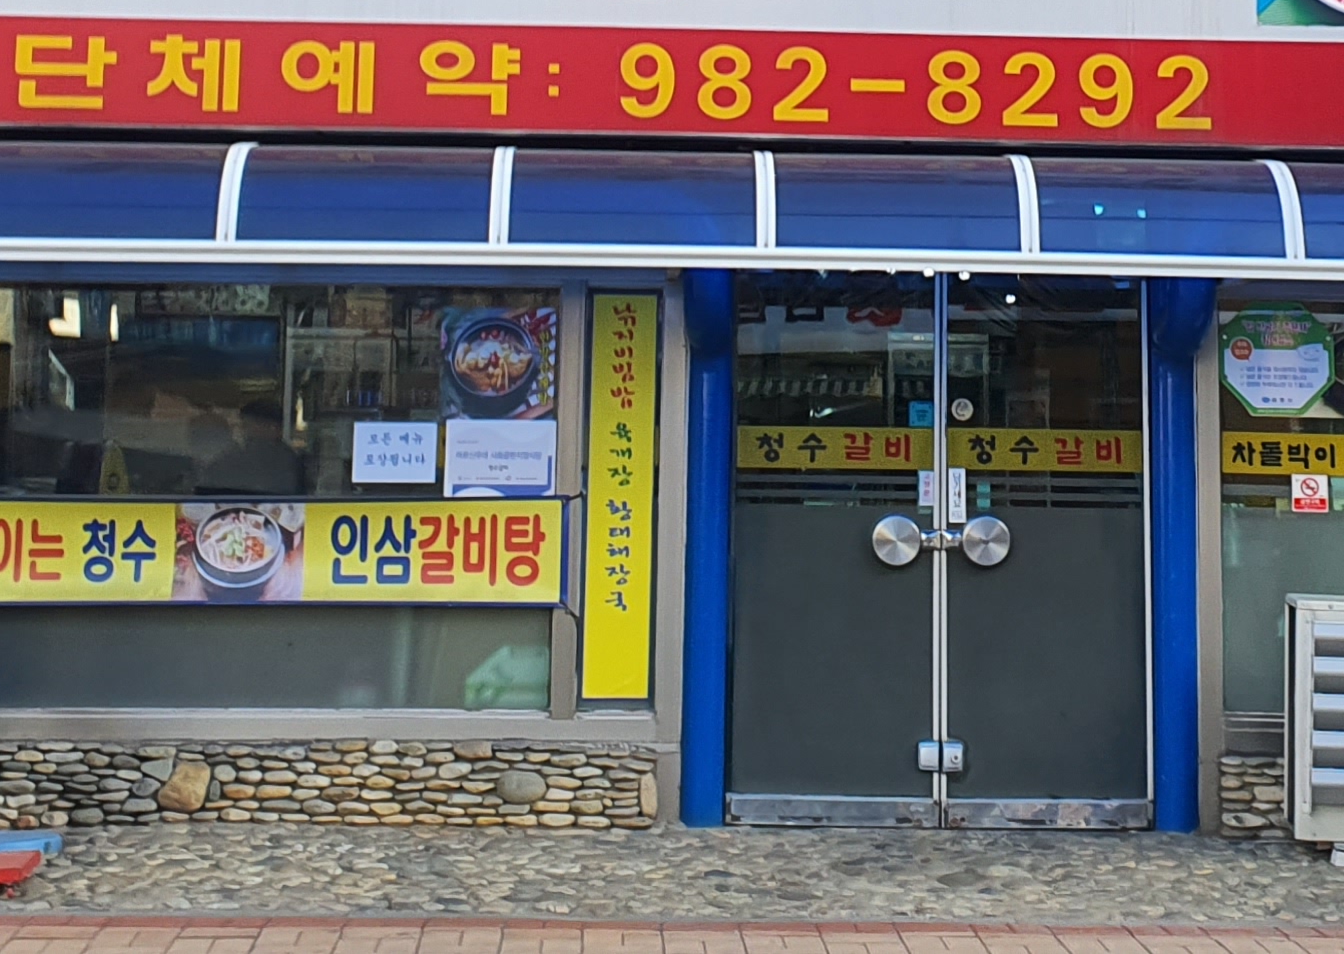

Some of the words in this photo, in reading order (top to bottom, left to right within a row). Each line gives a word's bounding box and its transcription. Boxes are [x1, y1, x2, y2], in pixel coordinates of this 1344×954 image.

[13, 33, 562, 117] 단체예약:
[618, 41, 1214, 132] 982-8292
[607, 421, 634, 487] 육개장
[755, 431, 913, 464] 청수갈비
[967, 433, 1123, 466] 청수갈비
[1231, 440, 1336, 470] 차돌박이
[81, 517, 158, 584] 청수
[330, 512, 547, 588] 인삼갈비탕
[605, 498, 634, 612] 황태해장국
